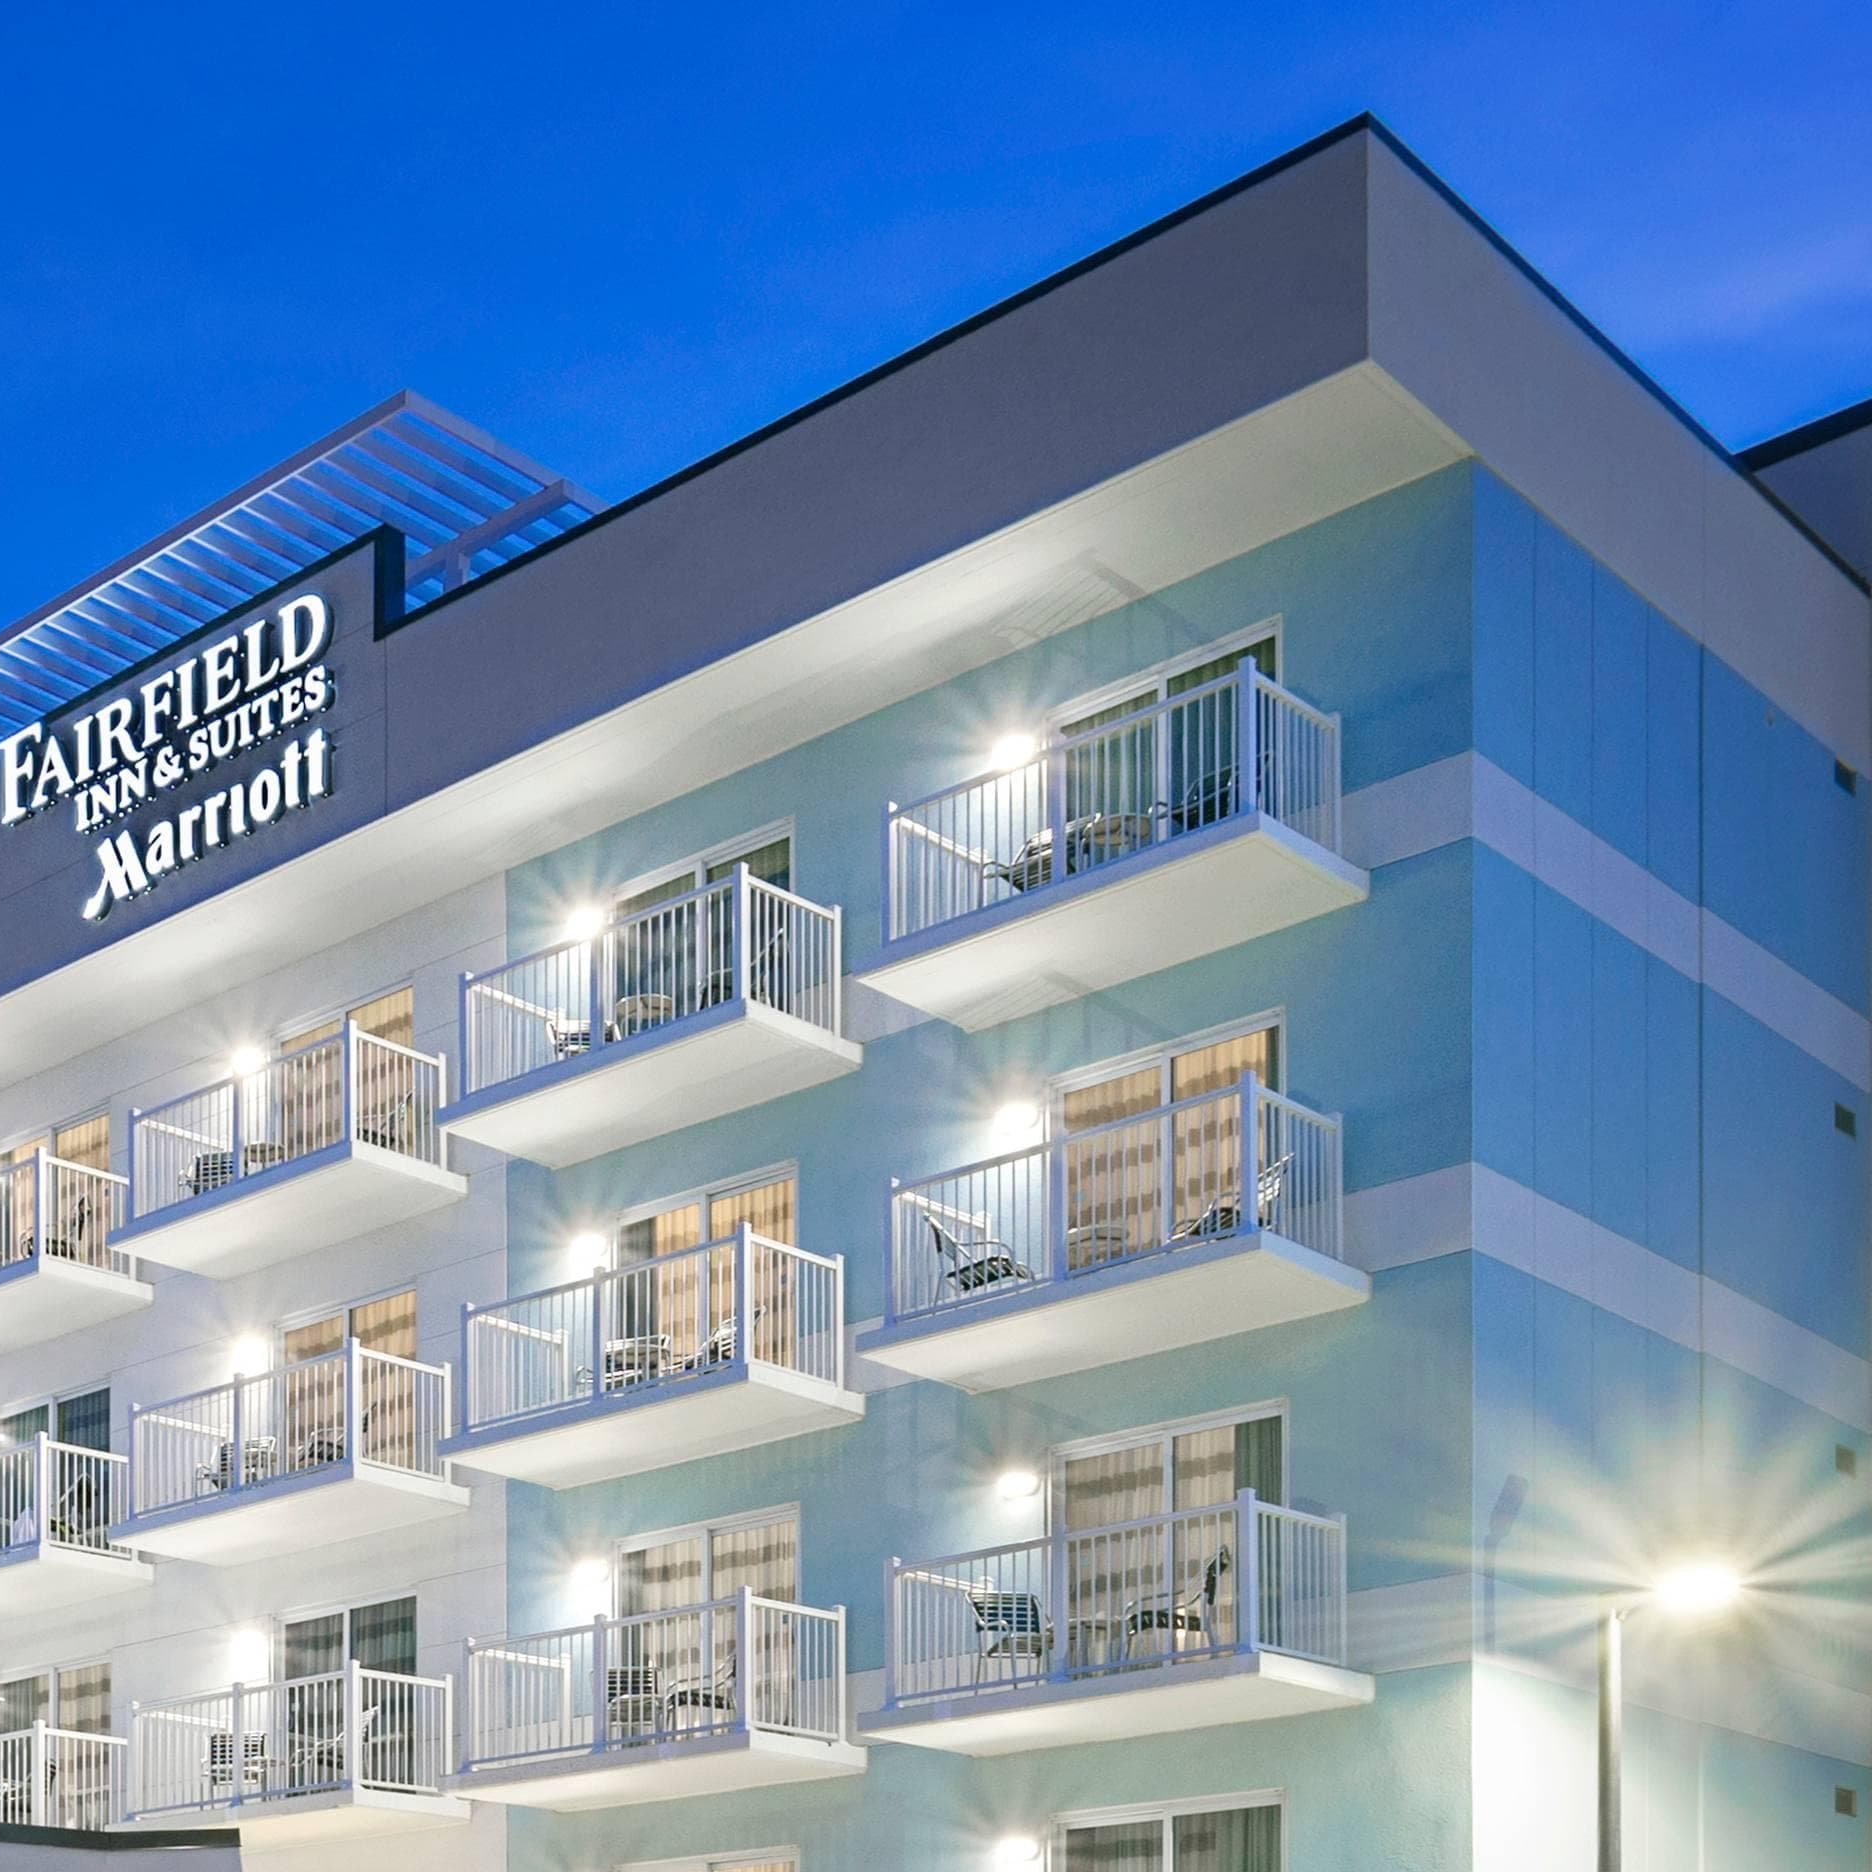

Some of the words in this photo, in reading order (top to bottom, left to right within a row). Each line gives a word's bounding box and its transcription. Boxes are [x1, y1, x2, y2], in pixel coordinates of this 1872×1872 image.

[75, 757, 147, 832] INN
[151, 745, 185, 789] &
[188, 664, 328, 772] SUITES
[81, 727, 328, 920] Marriott
